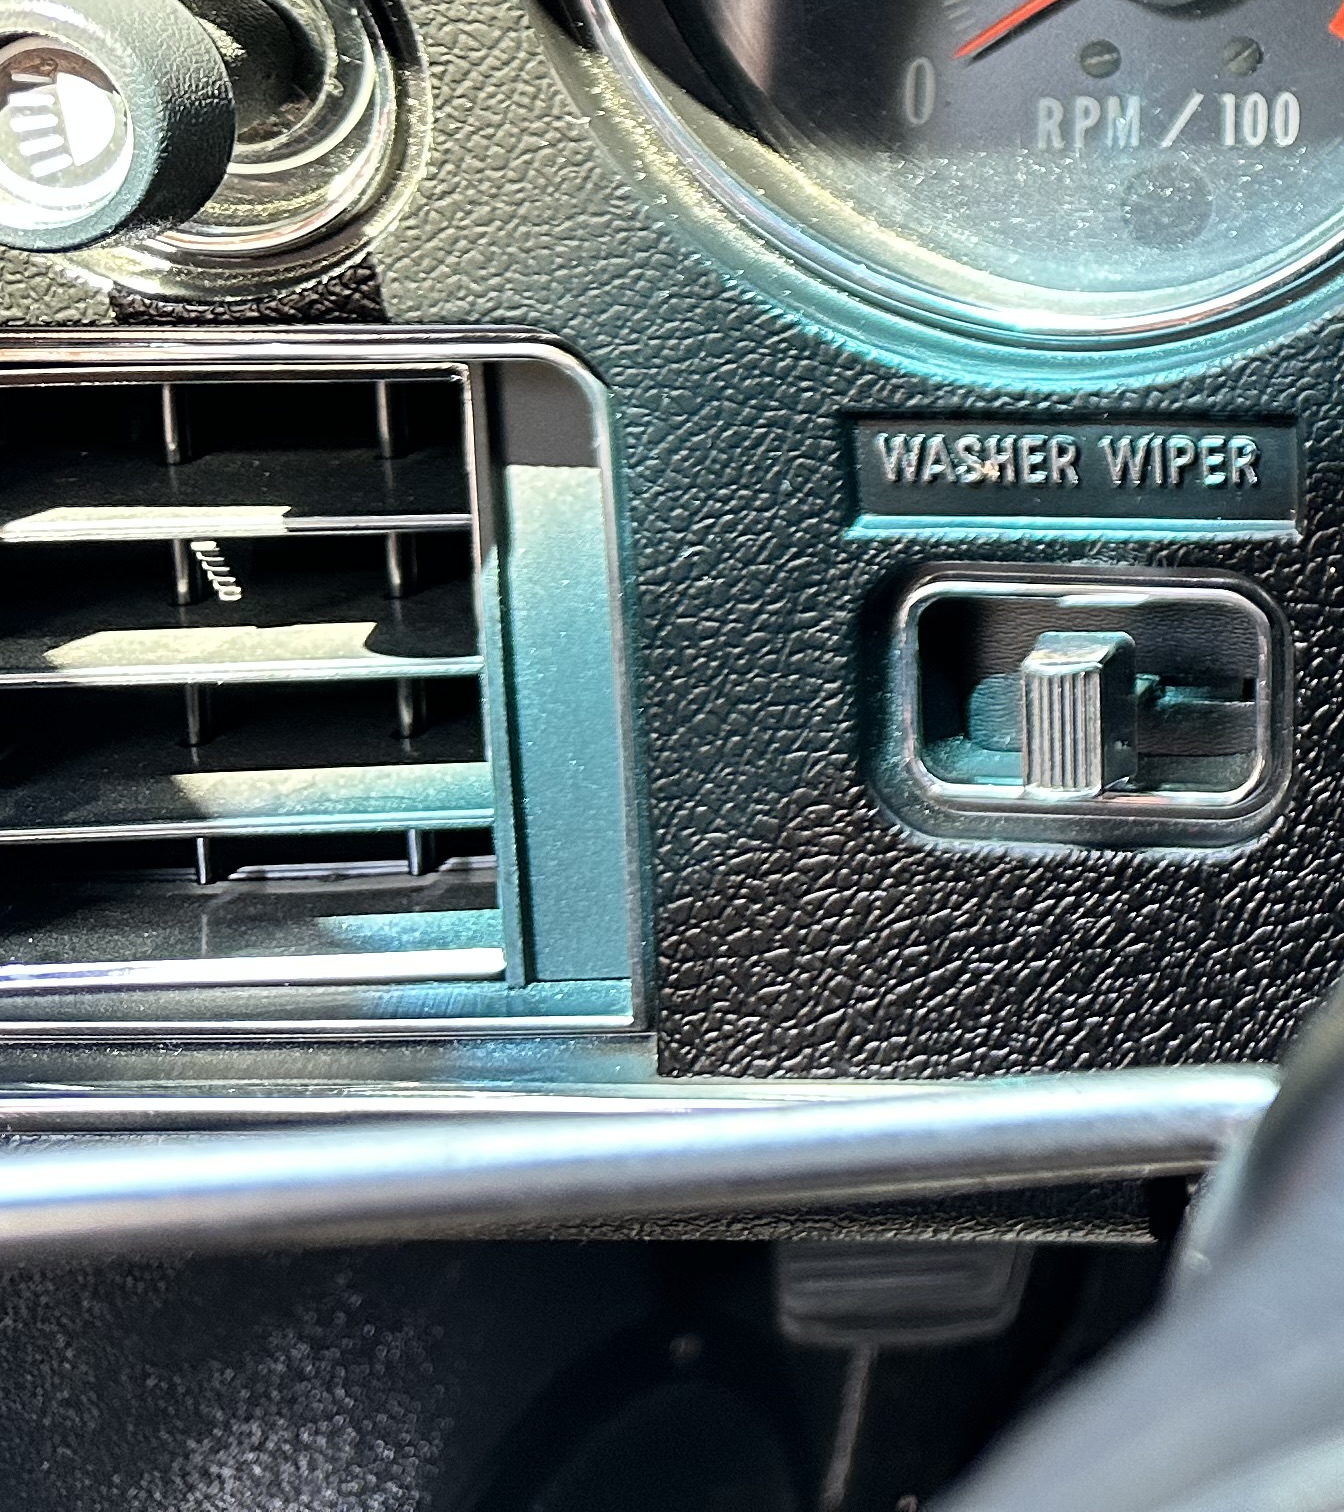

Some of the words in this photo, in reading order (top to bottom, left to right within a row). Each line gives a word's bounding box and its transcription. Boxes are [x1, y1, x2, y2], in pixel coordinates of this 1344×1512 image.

[905, 59, 935, 125] 0
[1037, 95, 1141, 148] RPM
[1221, 92, 1300, 145] 100
[877, 433, 1079, 484] WASHER
[1099, 434, 1258, 485] WIPER
